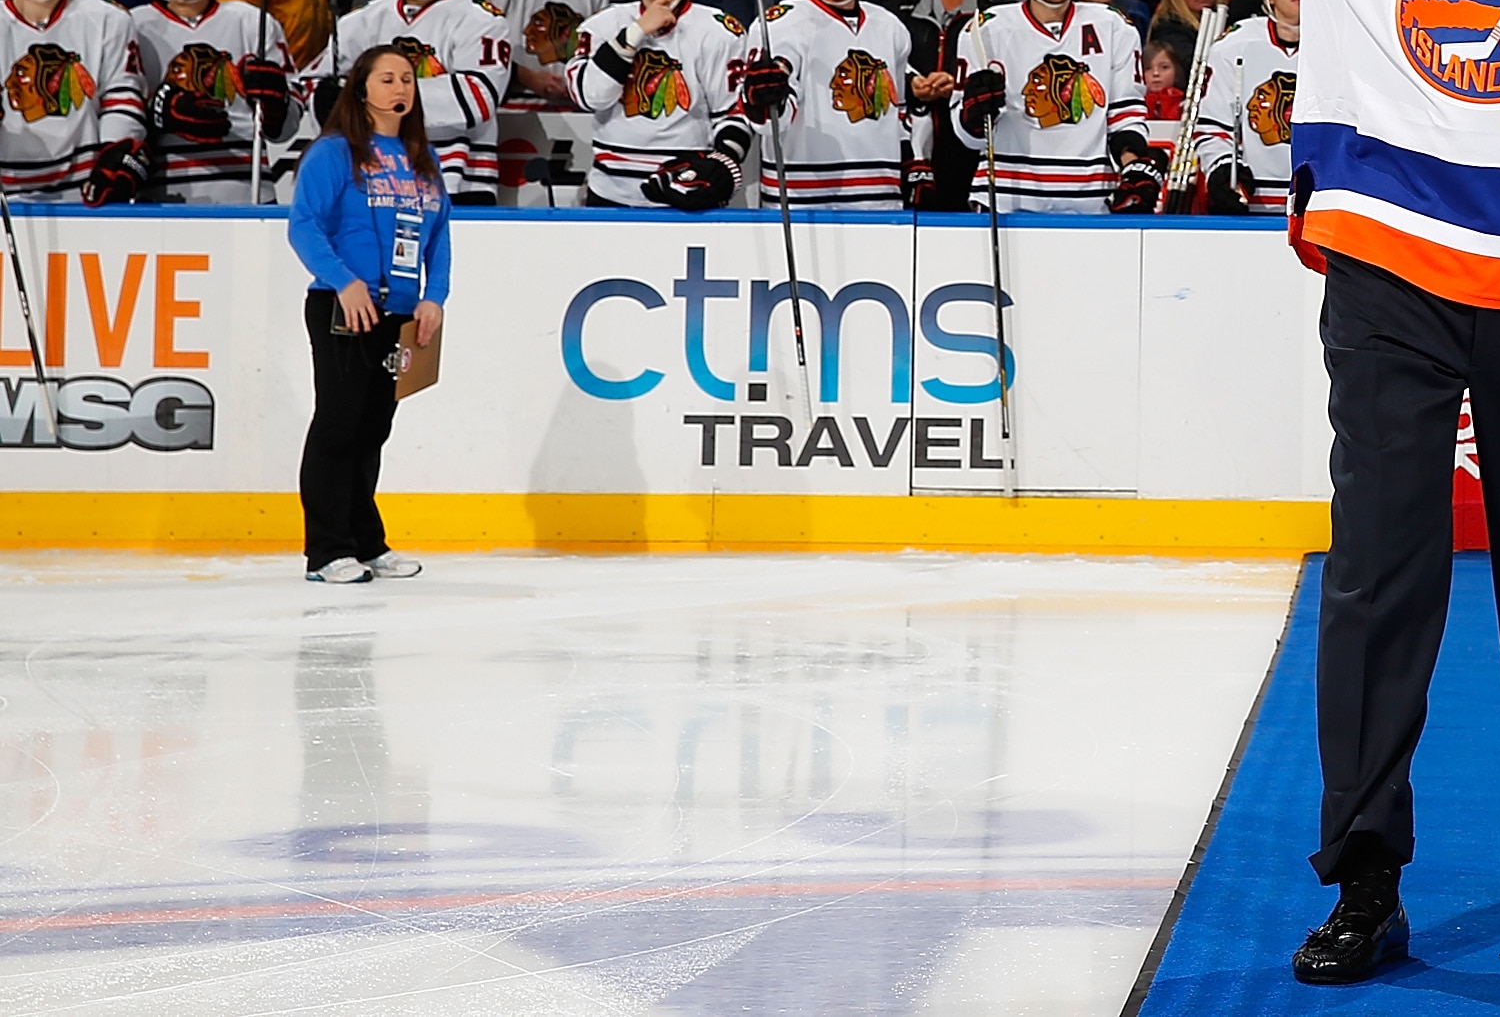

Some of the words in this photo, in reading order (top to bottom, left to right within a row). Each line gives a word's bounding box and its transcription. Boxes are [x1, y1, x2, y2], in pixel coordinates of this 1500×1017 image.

[1080, 23, 1104, 56] A
[561, 245, 1017, 404] ctms
[683, 415, 1016, 469] TRAVEL
